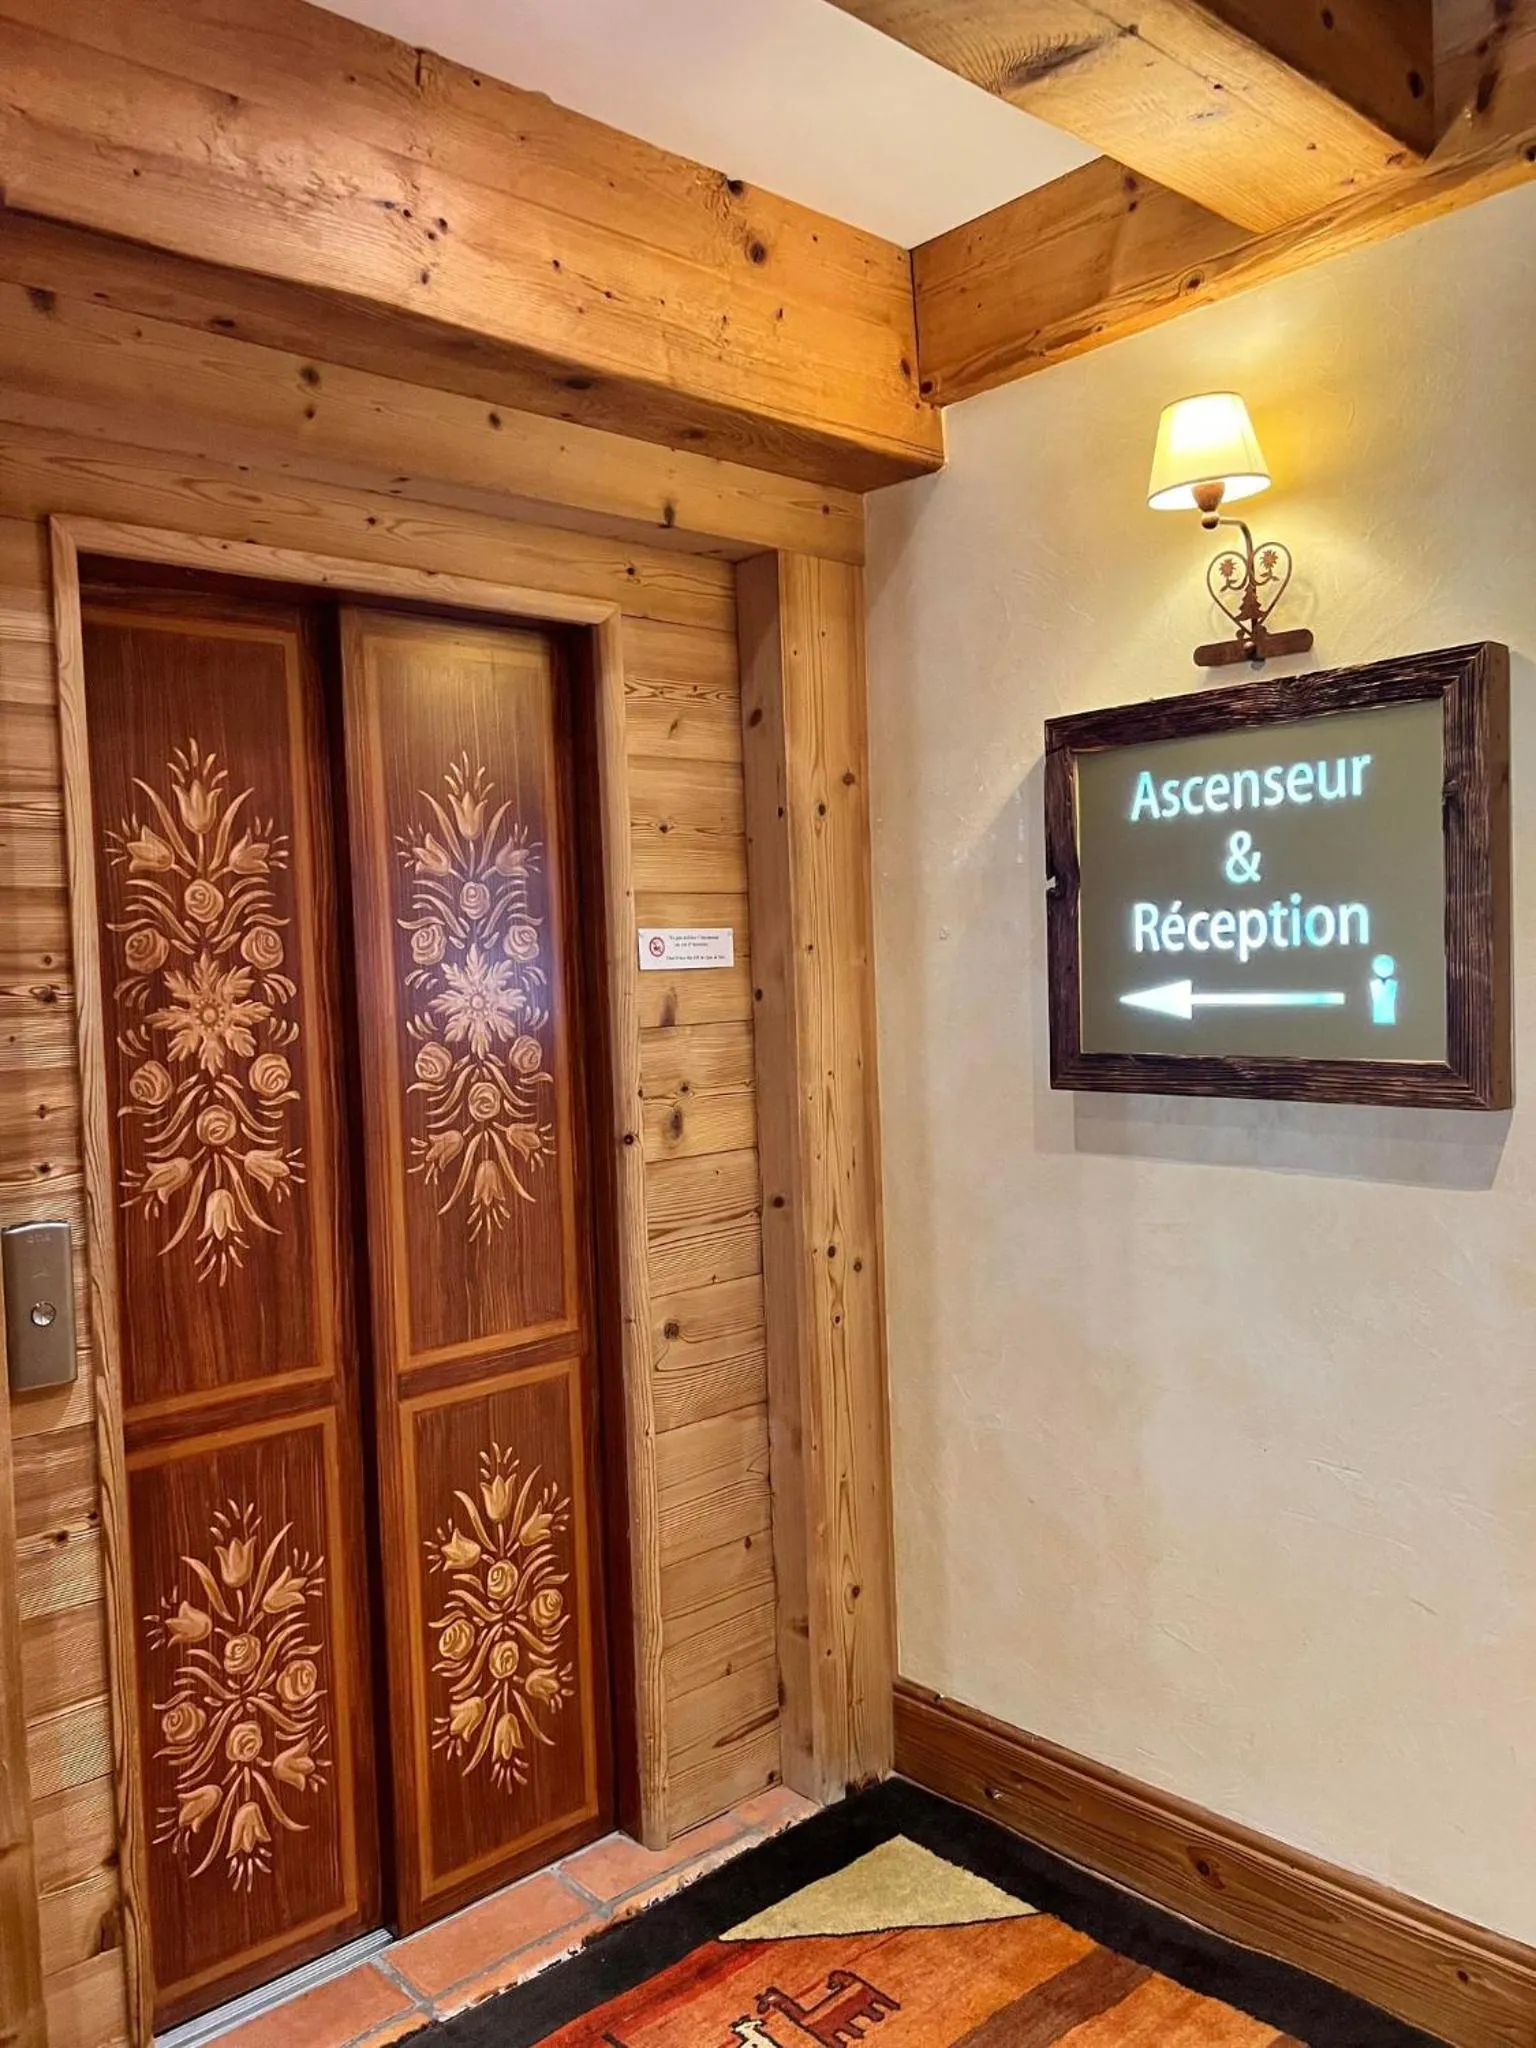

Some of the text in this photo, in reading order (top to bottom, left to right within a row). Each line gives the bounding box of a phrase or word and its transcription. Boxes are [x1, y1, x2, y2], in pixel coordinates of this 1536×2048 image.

[1129, 754, 1373, 822] Ascenseur
[1224, 829, 1262, 883] &
[1131, 892, 1371, 962] Réception
